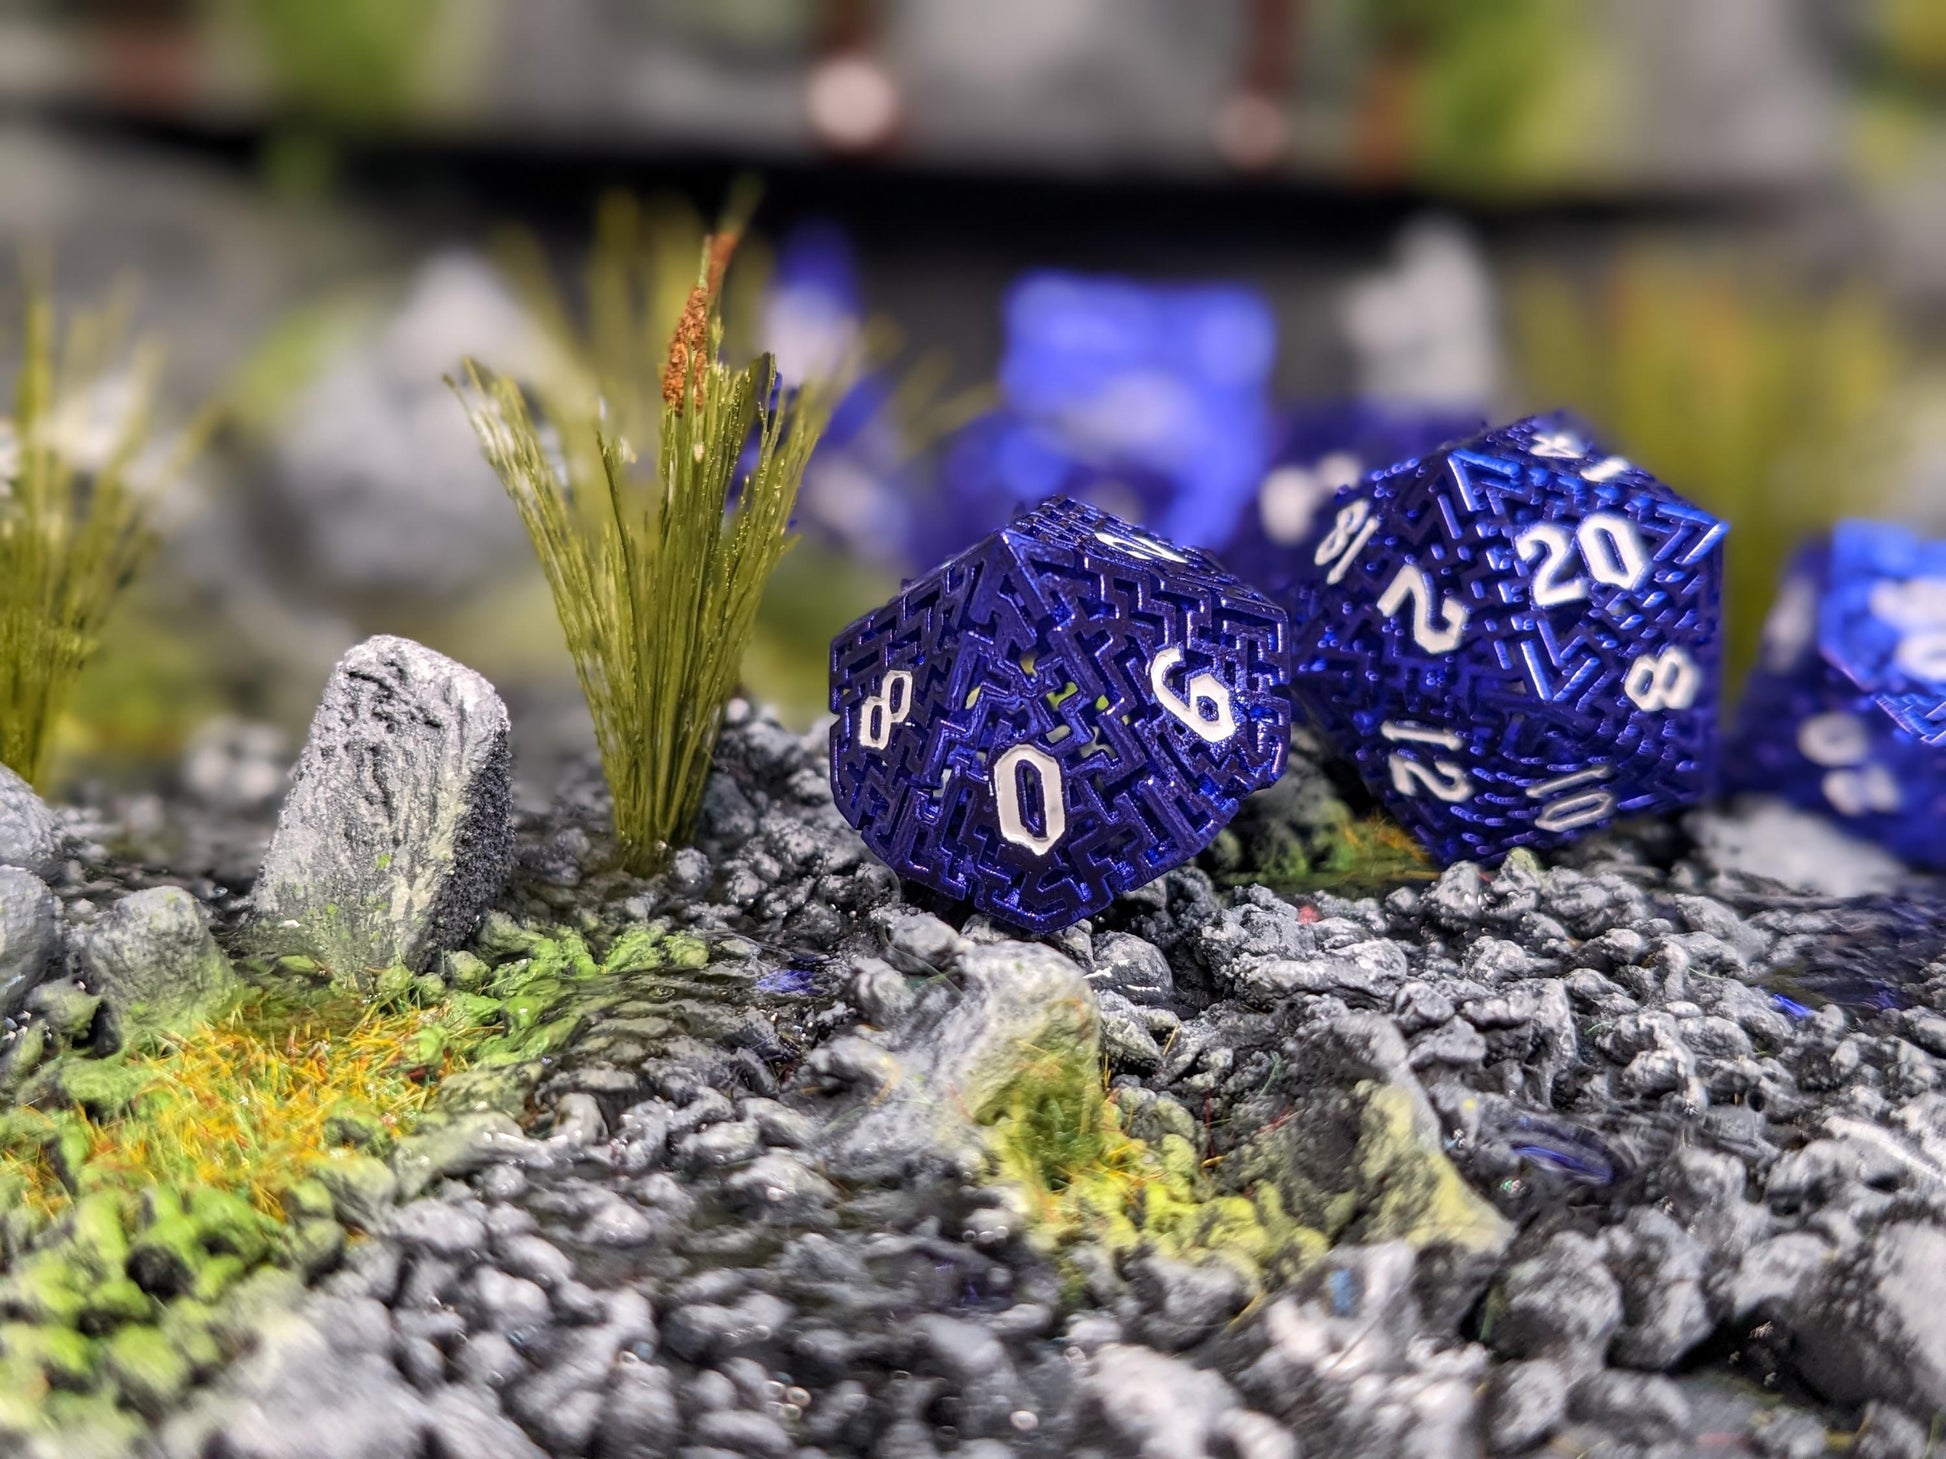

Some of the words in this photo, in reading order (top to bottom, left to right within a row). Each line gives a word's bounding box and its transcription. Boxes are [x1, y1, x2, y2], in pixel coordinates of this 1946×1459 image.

[1514, 512, 1650, 610] 20
[1375, 563, 1470, 655] 2
[857, 668, 914, 751] 8
[1149, 647, 1236, 744] 6
[1623, 645, 1699, 713] 8
[992, 742, 1067, 857] 0
[1380, 718, 1474, 802] 12
[1524, 766, 1615, 833] 10
